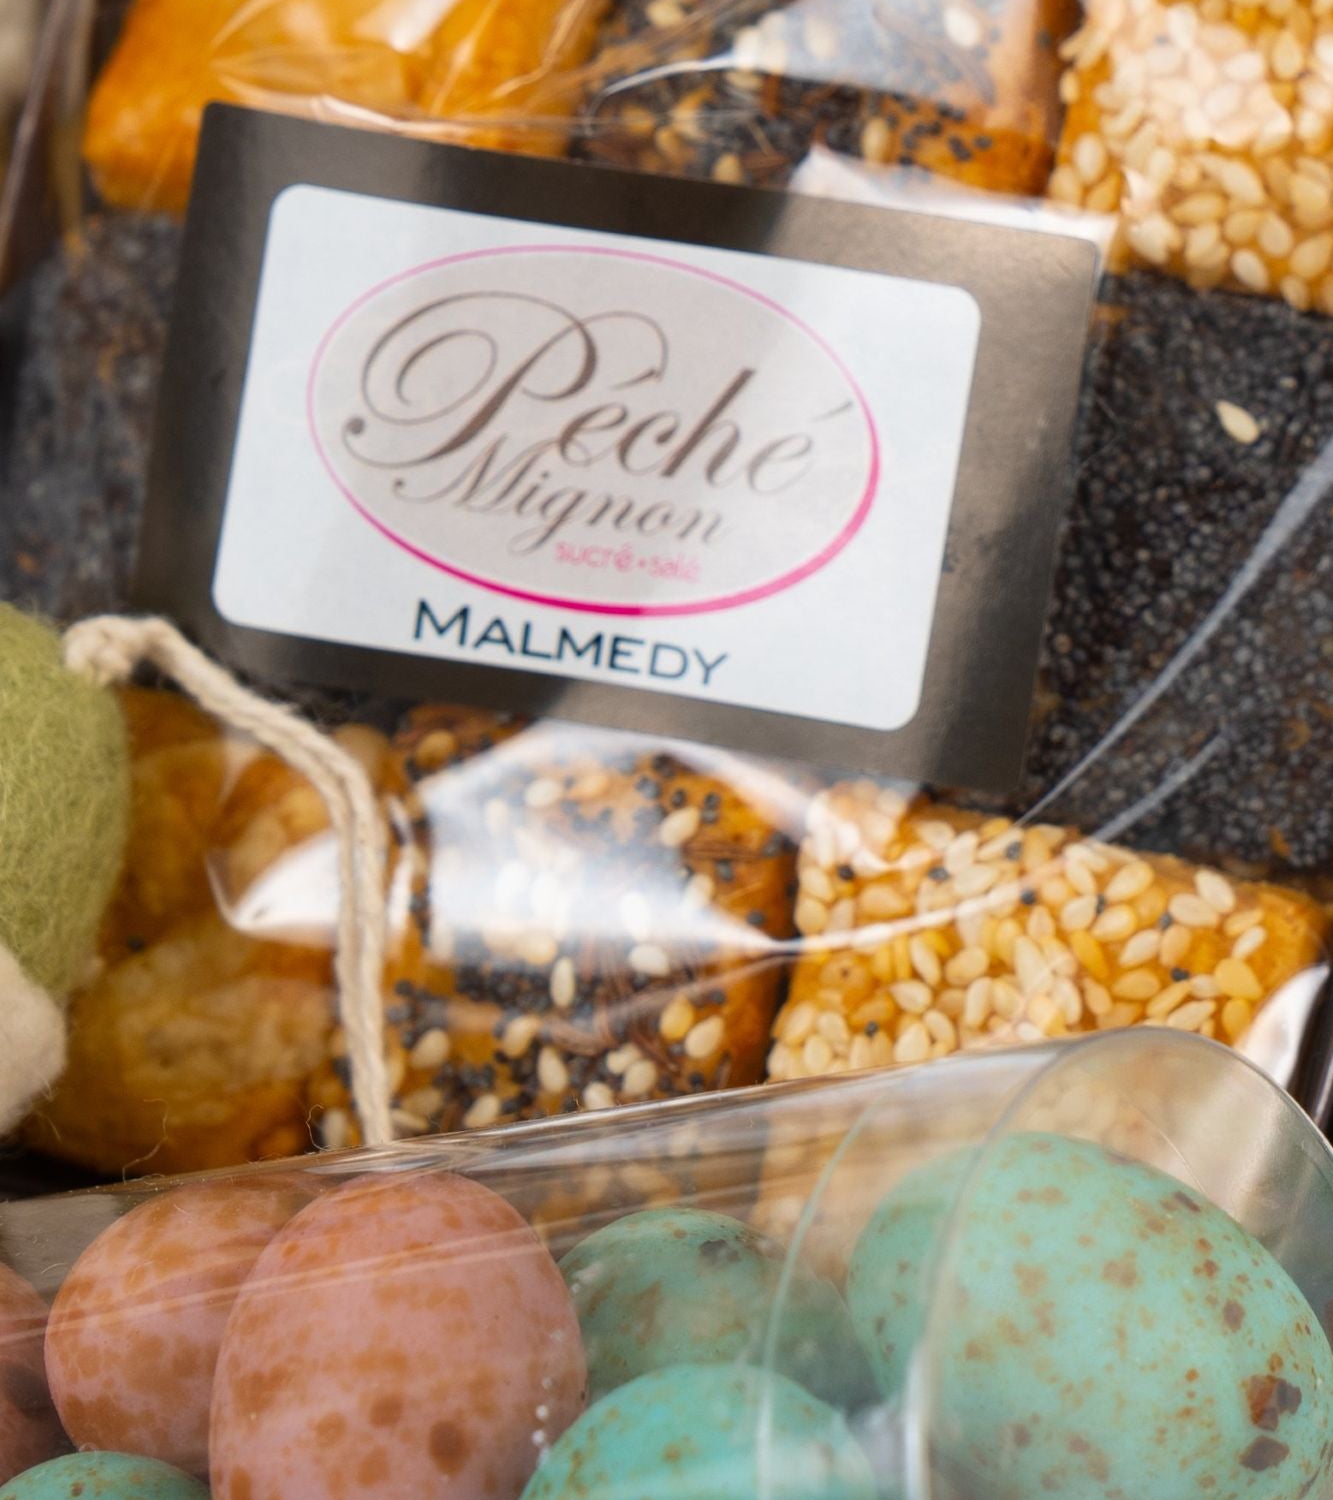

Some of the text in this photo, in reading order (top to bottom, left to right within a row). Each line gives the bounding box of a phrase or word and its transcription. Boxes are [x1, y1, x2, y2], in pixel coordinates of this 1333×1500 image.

[341, 289, 855, 494] Péché
[391, 431, 727, 556] Mignon
[413, 597, 728, 686] MALMEDY
